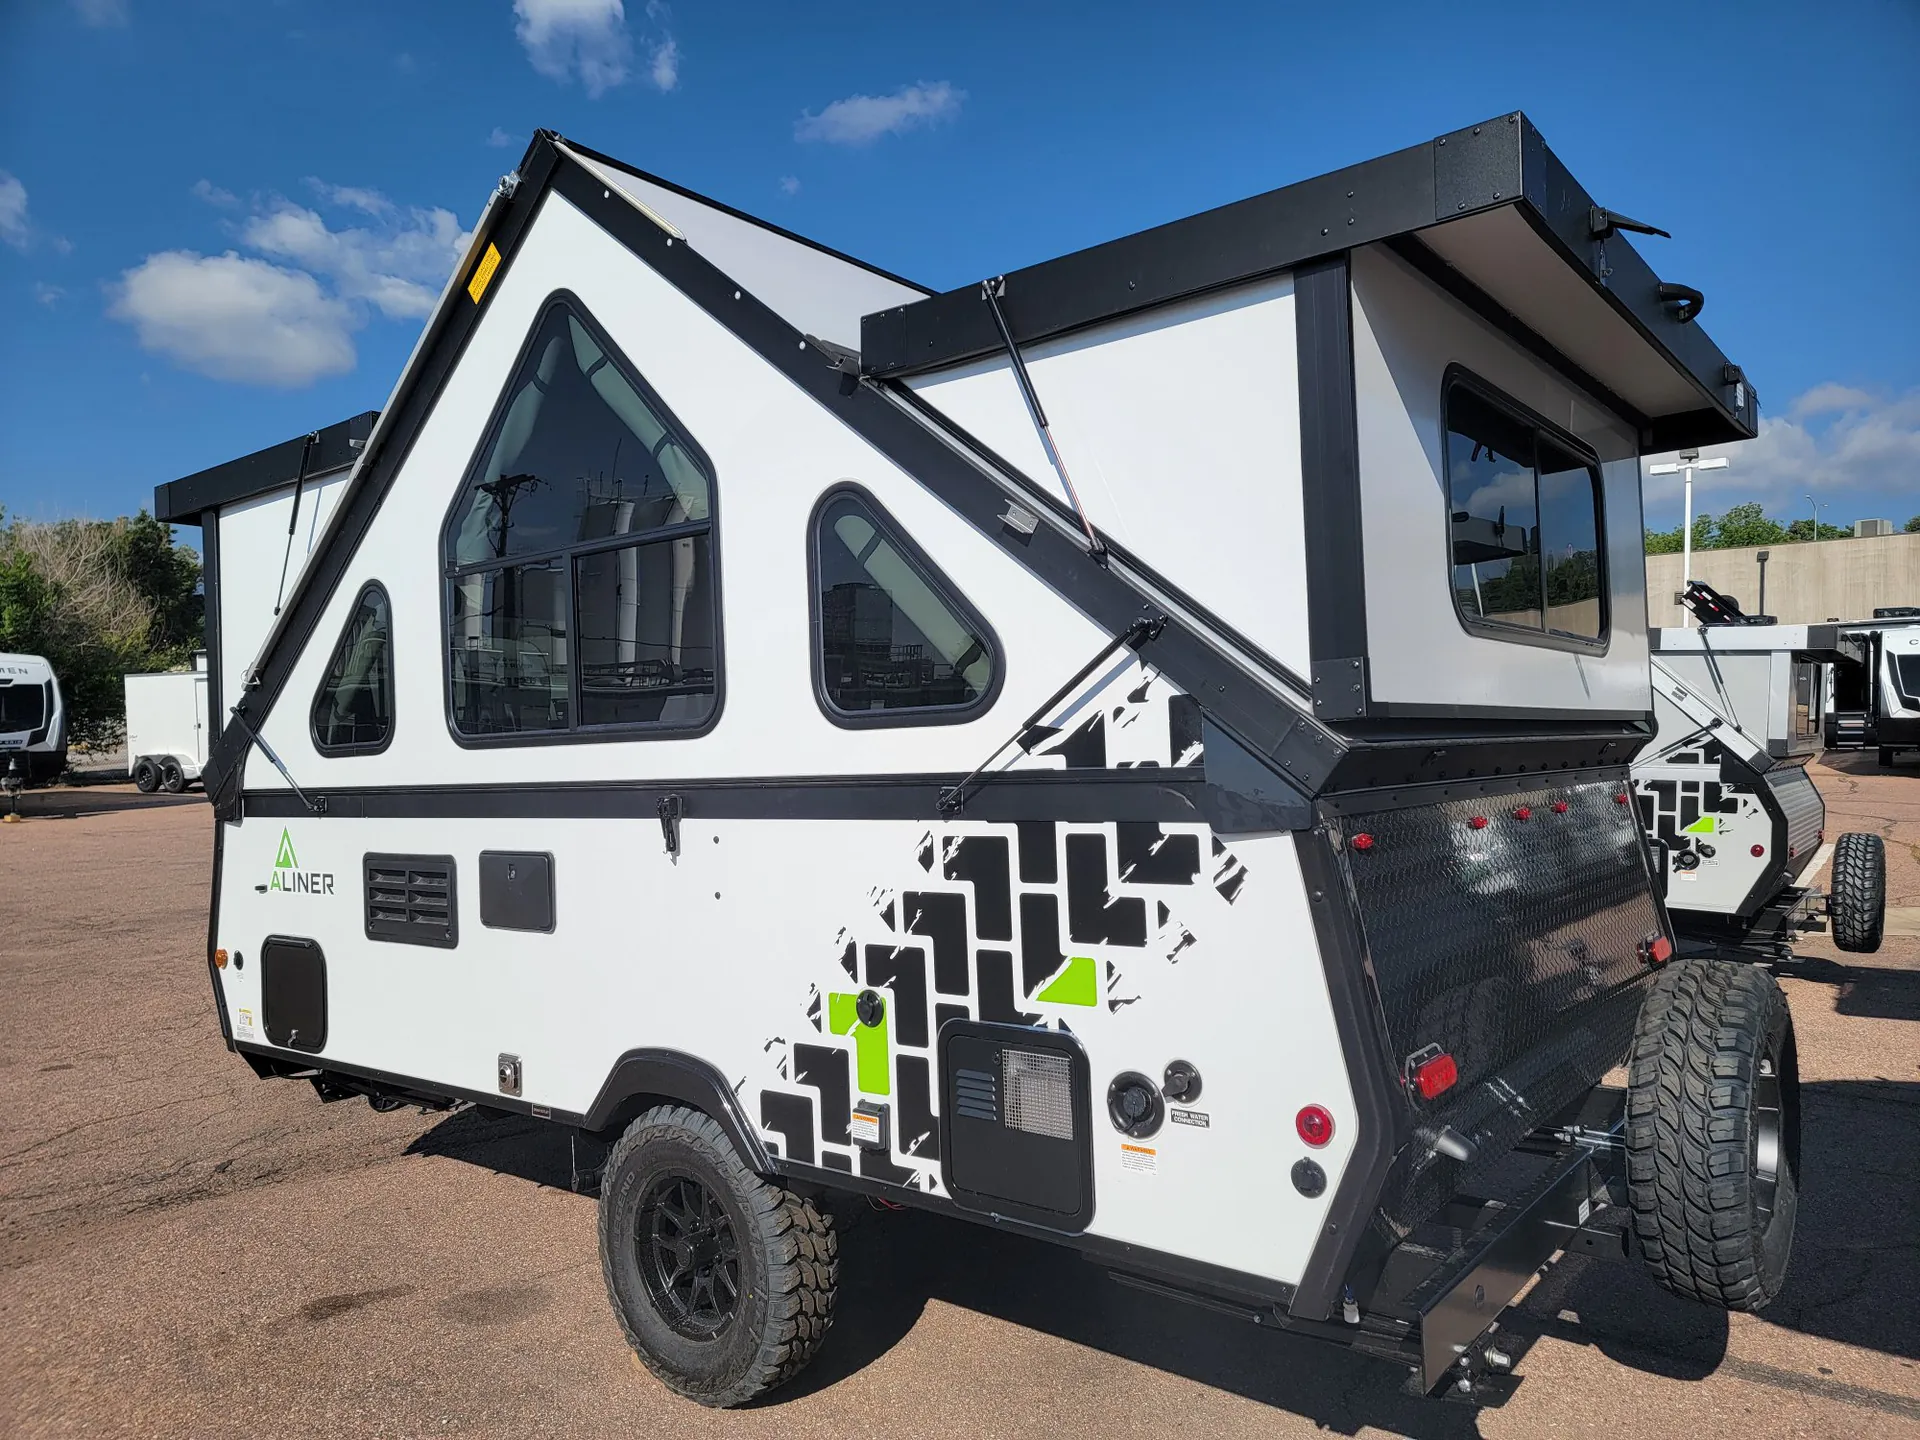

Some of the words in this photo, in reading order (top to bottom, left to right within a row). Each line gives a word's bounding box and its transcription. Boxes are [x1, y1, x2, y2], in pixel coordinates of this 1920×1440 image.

[270, 870, 335, 895] ALINER
[1171, 1110, 1189, 1119] FRESH
[1189, 1112, 1209, 1122] WATER
[1173, 1115, 1207, 1128] CONNECTION
